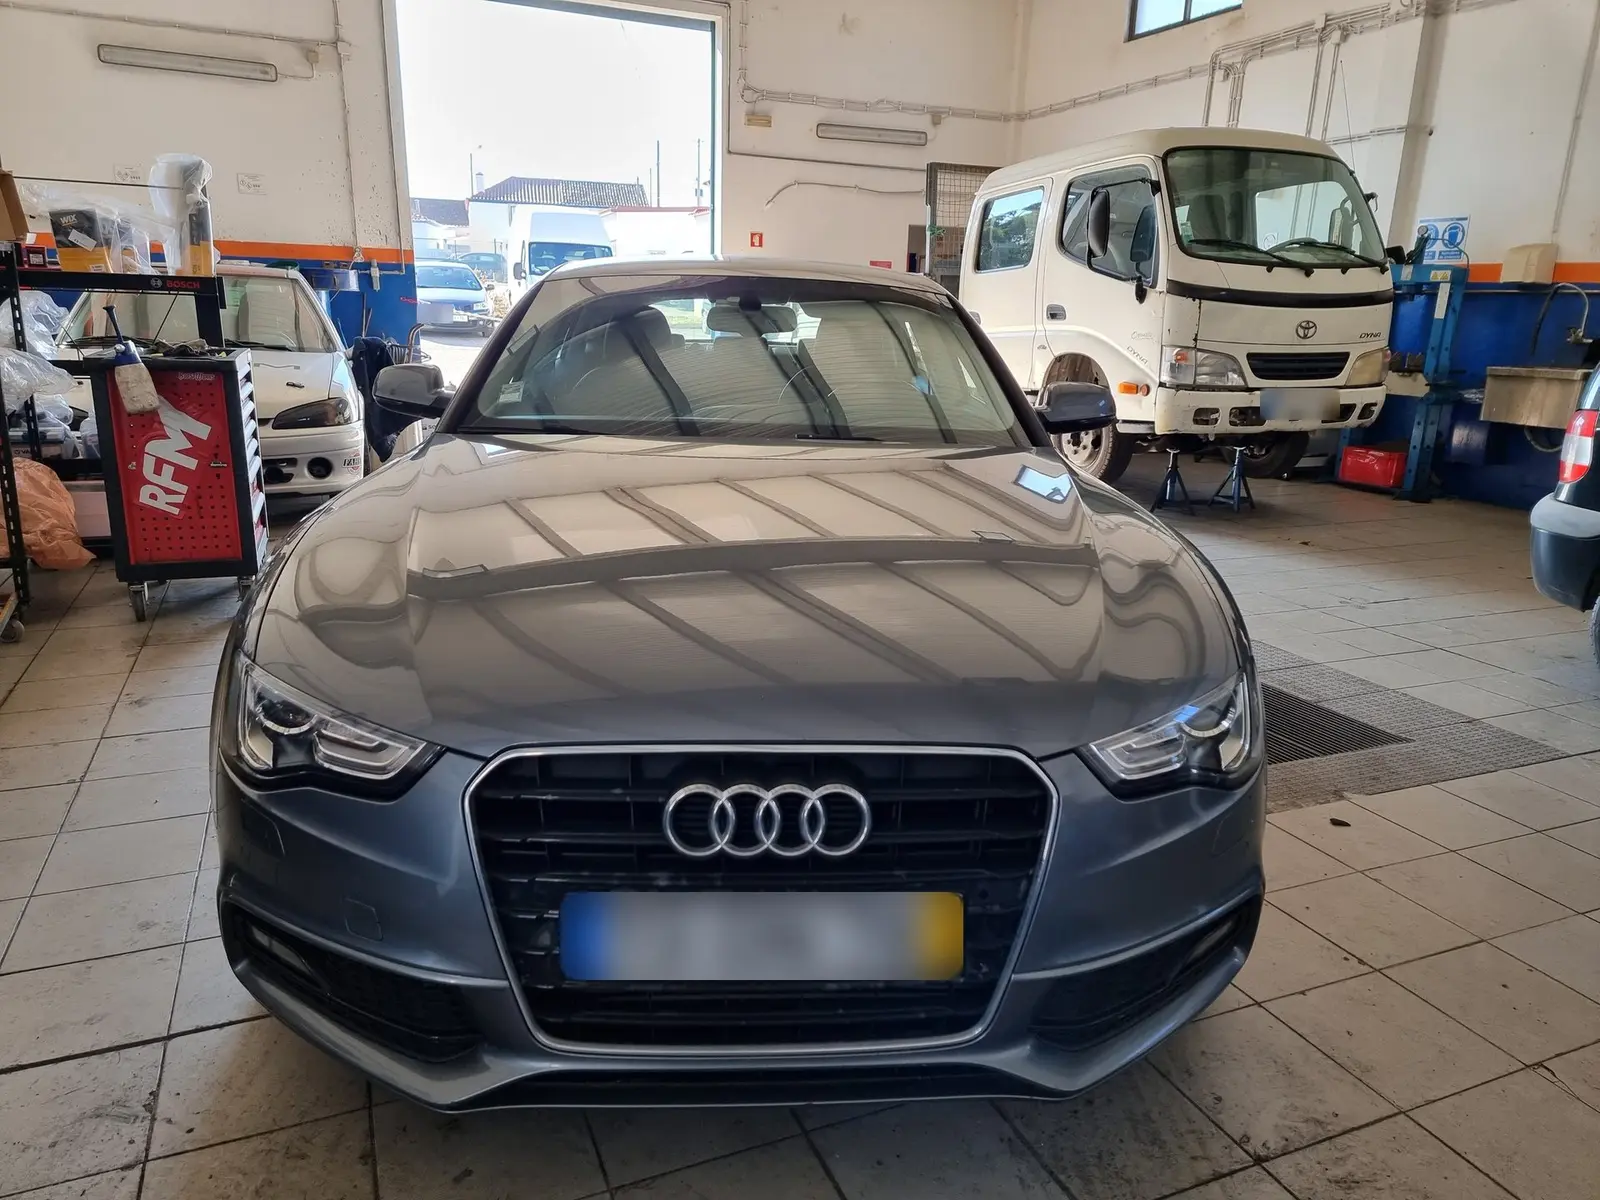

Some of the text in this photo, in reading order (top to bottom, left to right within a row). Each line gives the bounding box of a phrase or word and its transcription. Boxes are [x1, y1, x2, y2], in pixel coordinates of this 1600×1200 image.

[60, 214, 77, 224] WIX
[166, 280, 200, 289] BOSCH
[1126, 345, 1148, 365] DYNA
[139, 395, 212, 515] RFM
